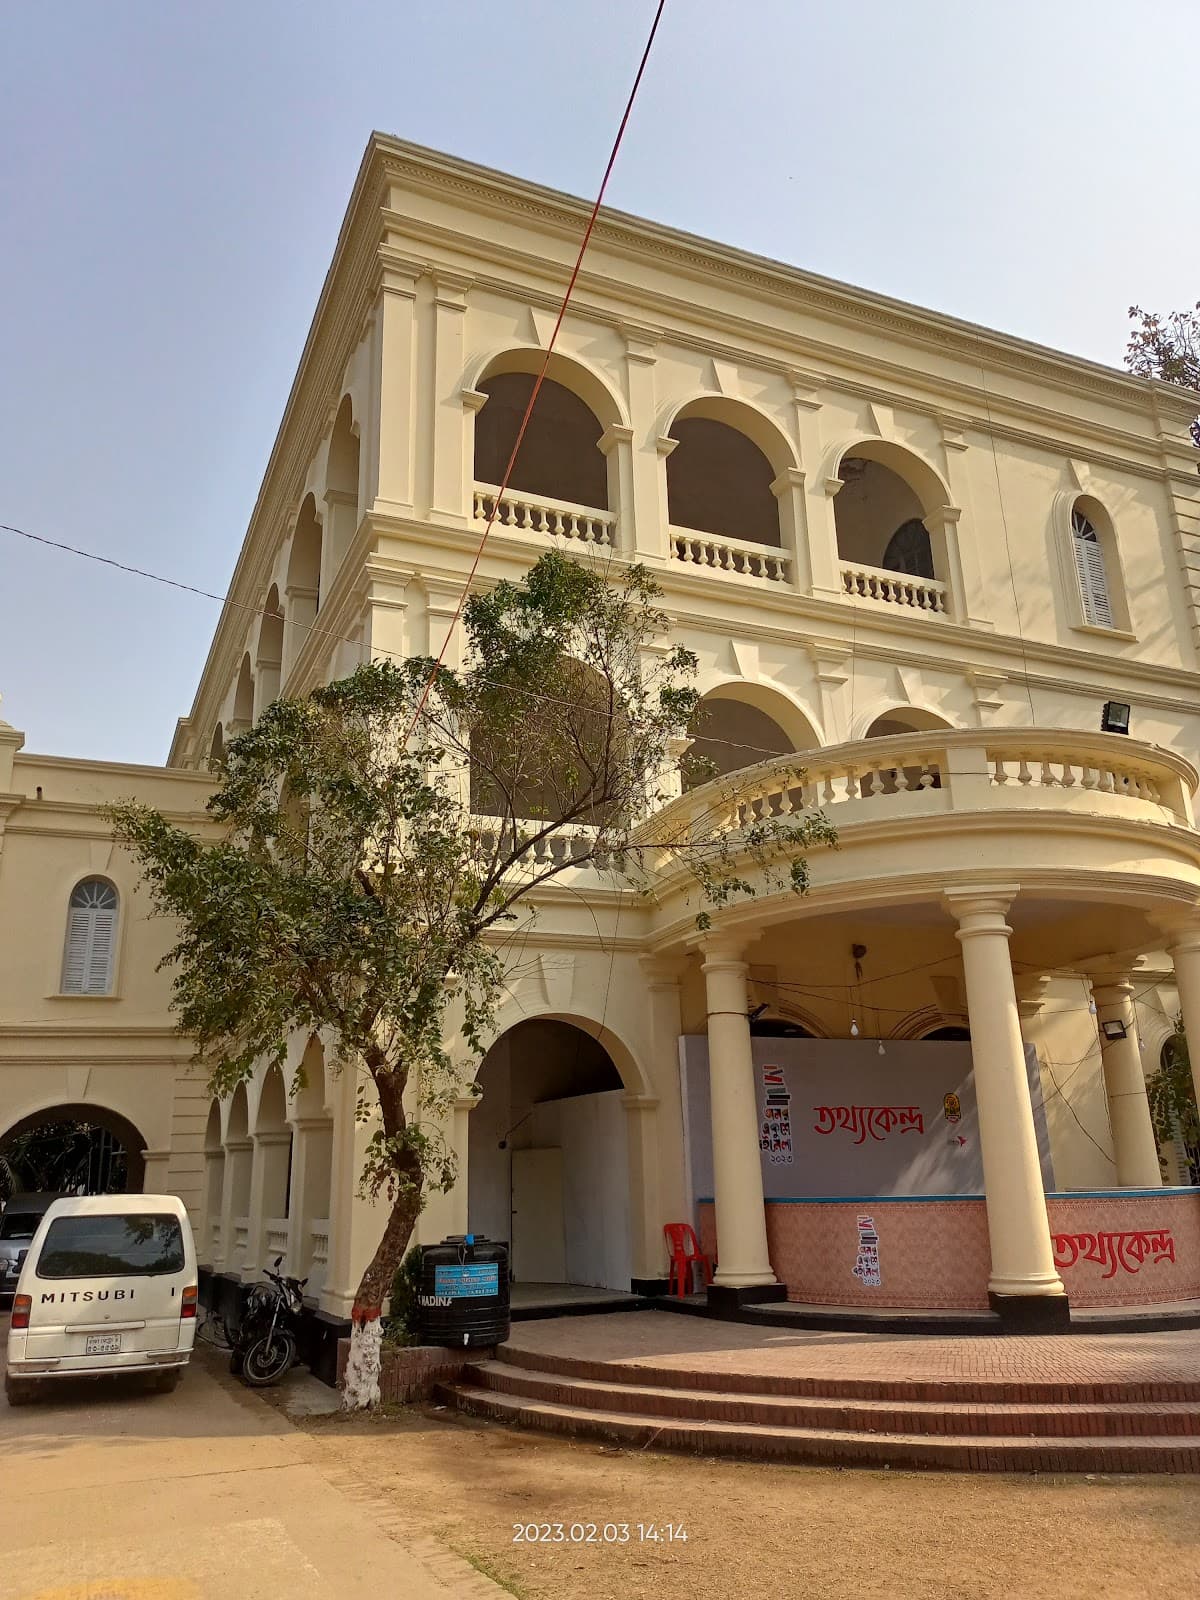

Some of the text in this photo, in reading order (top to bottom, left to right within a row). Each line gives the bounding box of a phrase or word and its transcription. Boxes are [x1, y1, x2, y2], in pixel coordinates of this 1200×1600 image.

[813, 1104, 924, 1145] তথ্যকেন্দ্র
[770, 1154, 793, 1164] ২০২৩
[1051, 1228, 1176, 1279] তথ্যকেন্দ্র
[41, 1288, 135, 1304] MITSUBI
